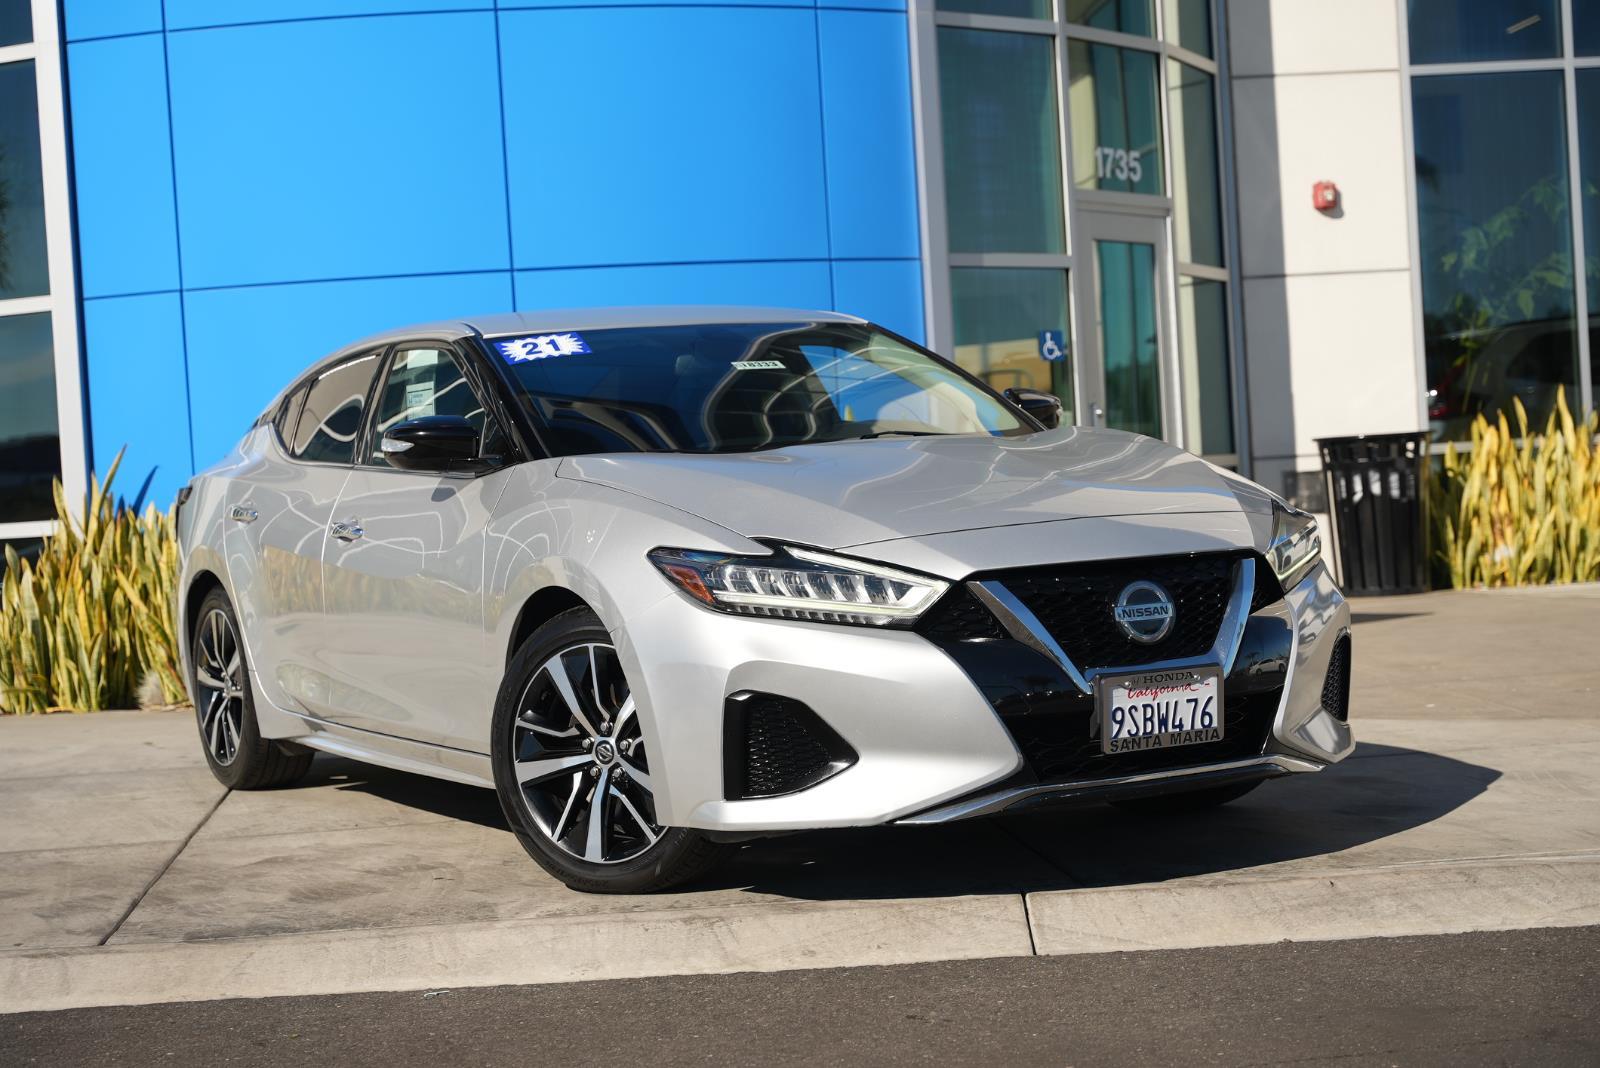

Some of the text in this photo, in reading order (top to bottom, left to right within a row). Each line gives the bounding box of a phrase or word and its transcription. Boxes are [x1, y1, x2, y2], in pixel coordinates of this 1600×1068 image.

[1095, 147, 1142, 183] 1735
[521, 338, 562, 356] 21
[1121, 605, 1169, 618] NISSAN
[1143, 671, 1195, 684] HONDA
[1111, 695, 1214, 740] 9SBW476
[1110, 728, 1220, 753] SANTA MARIA
